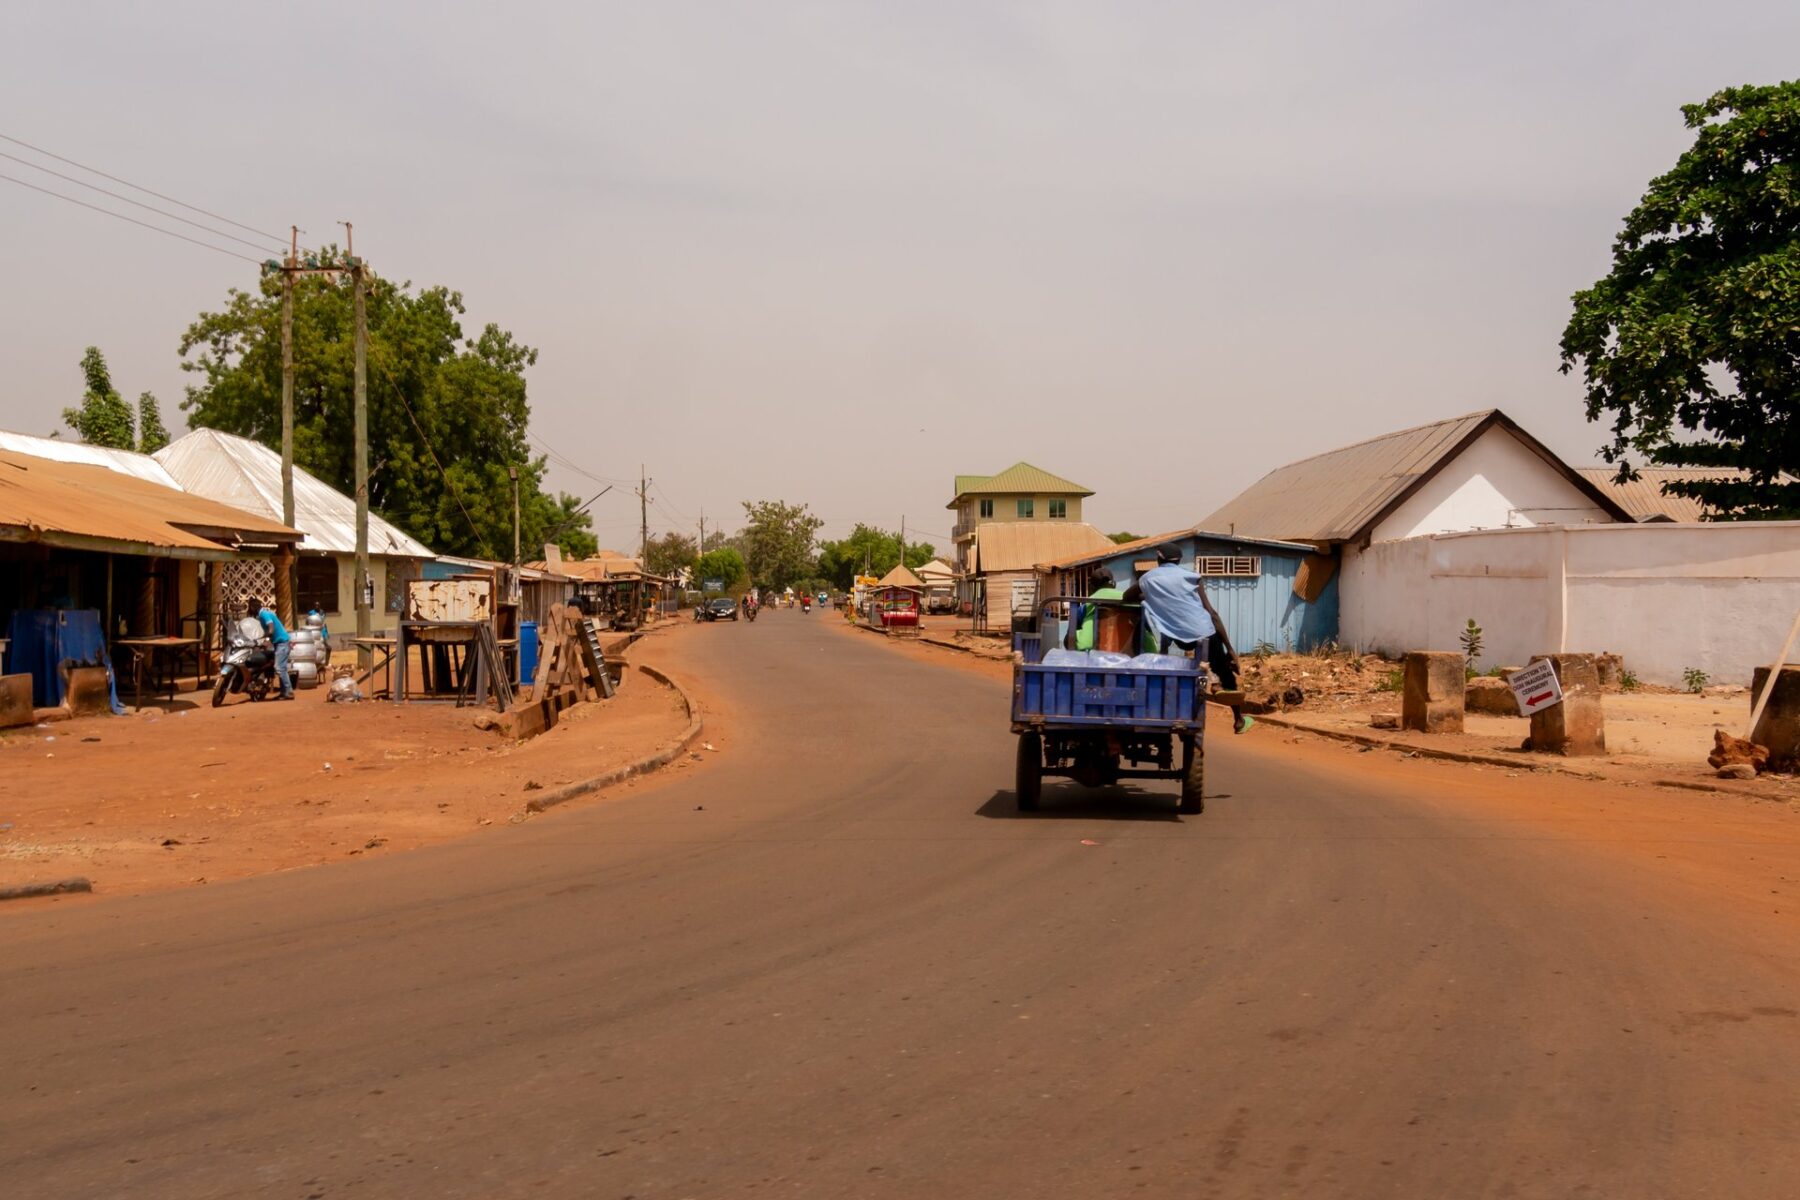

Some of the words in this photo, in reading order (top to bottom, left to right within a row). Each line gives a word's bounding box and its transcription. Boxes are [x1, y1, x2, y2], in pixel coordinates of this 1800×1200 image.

[1513, 669, 1539, 683] DIRECTION
[1524, 671, 1553, 687] INAUGURAL
[1522, 680, 1549, 695] CEREMONY
